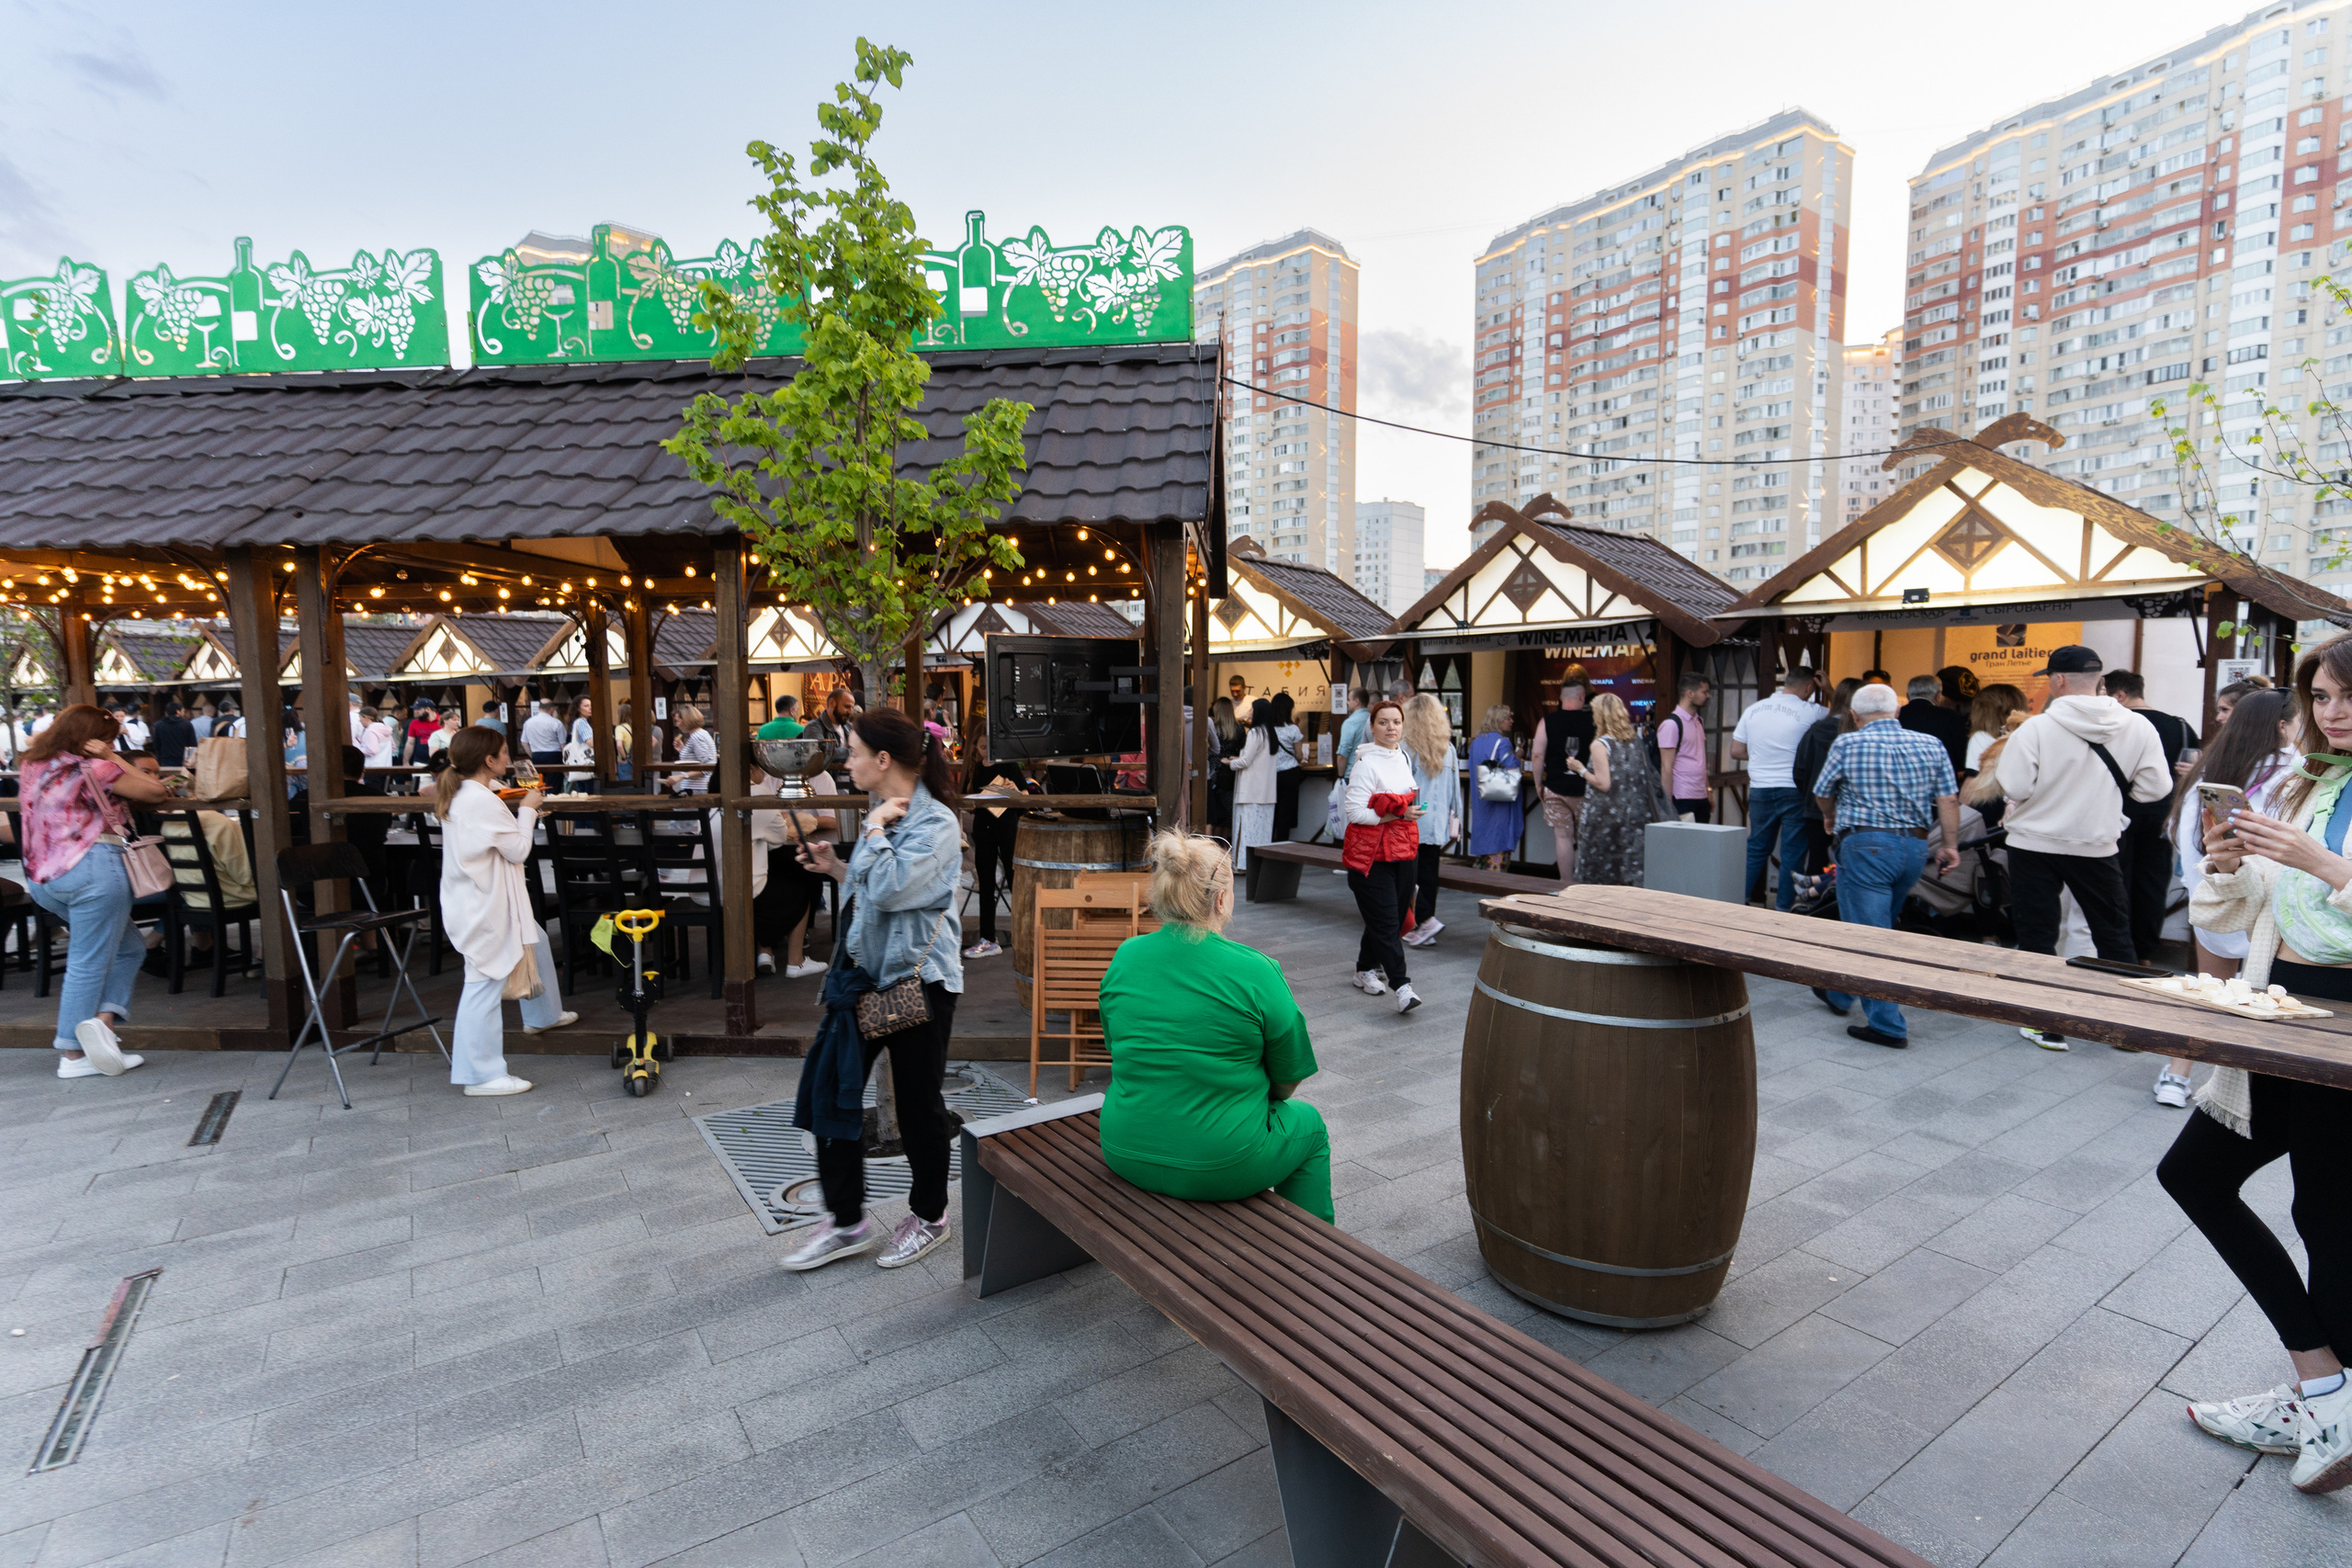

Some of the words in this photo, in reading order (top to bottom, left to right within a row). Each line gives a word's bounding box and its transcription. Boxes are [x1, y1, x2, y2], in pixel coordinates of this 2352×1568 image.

[1984, 601, 2072, 615] СЫРОВАРНЯ
[1518, 625, 1628, 645] WINEMAFIA
[1970, 649, 2007, 662] grand
[1245, 685, 1326, 696] ТАБИЯ
